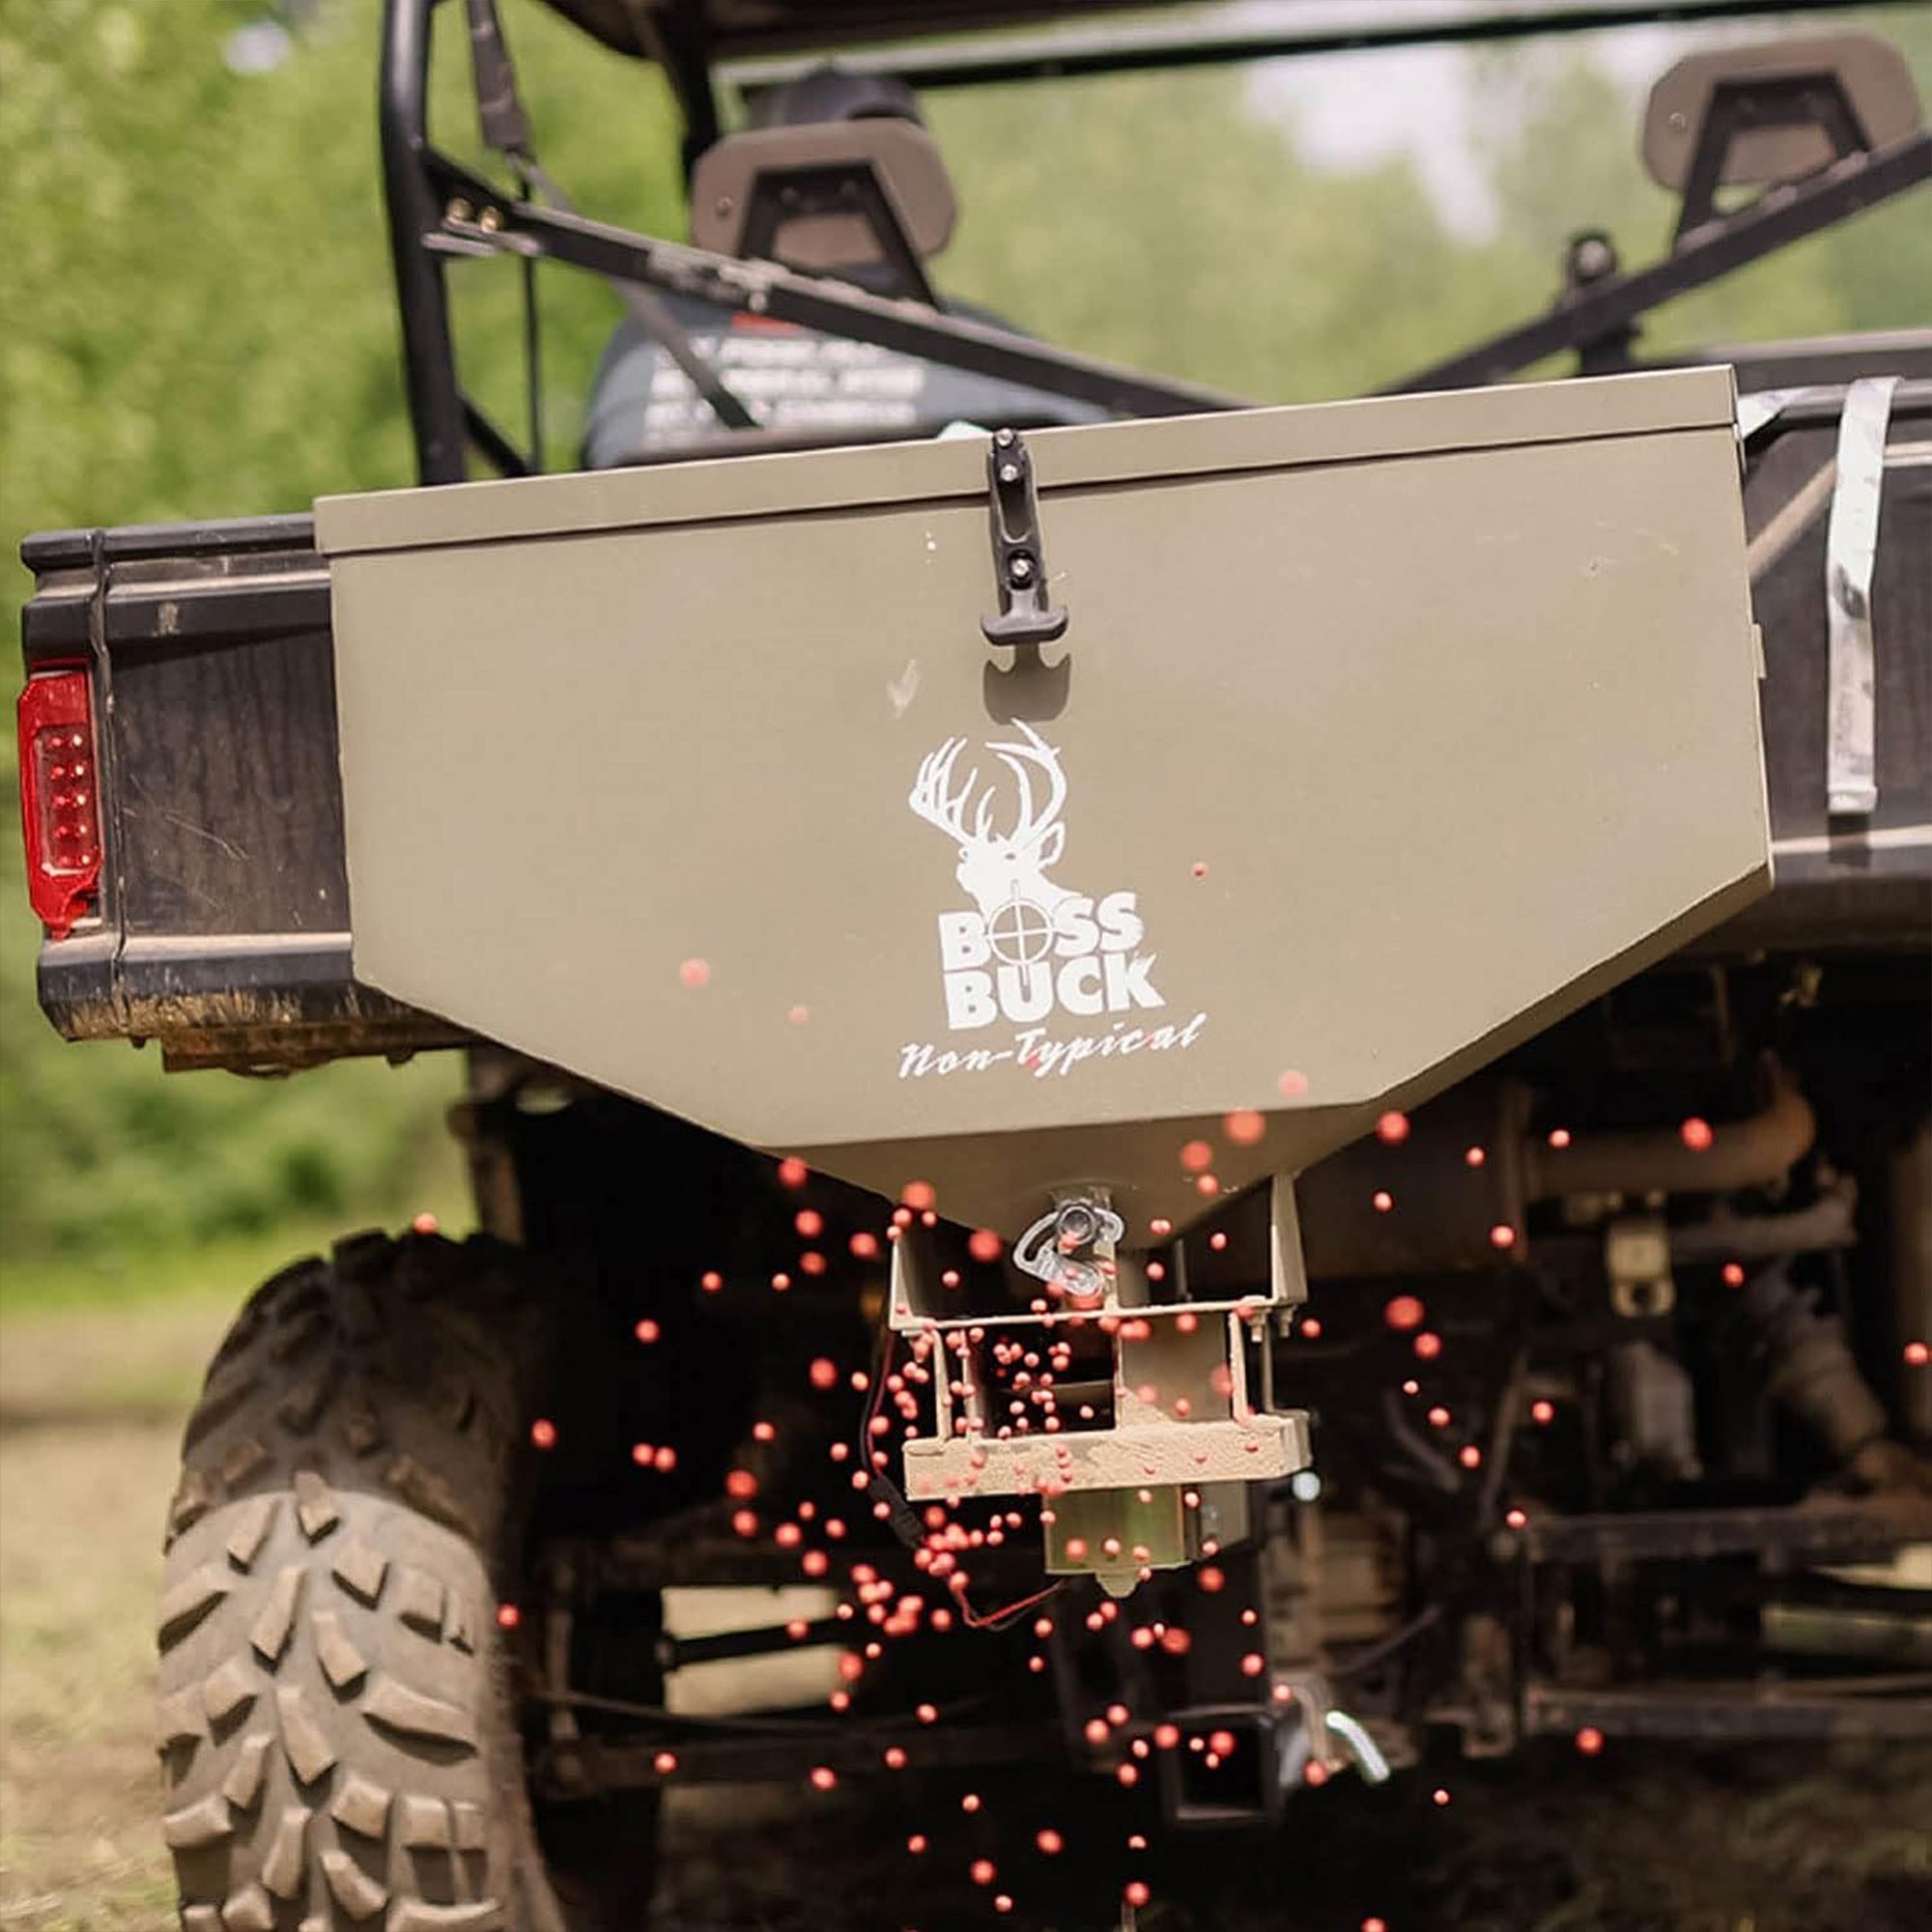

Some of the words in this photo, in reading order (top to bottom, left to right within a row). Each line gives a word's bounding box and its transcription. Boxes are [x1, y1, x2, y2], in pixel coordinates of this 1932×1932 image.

[938, 892, 1144, 971] BOSS
[943, 952, 1166, 1030] BUCK
[898, 1012, 1207, 1078] Non-Typical
